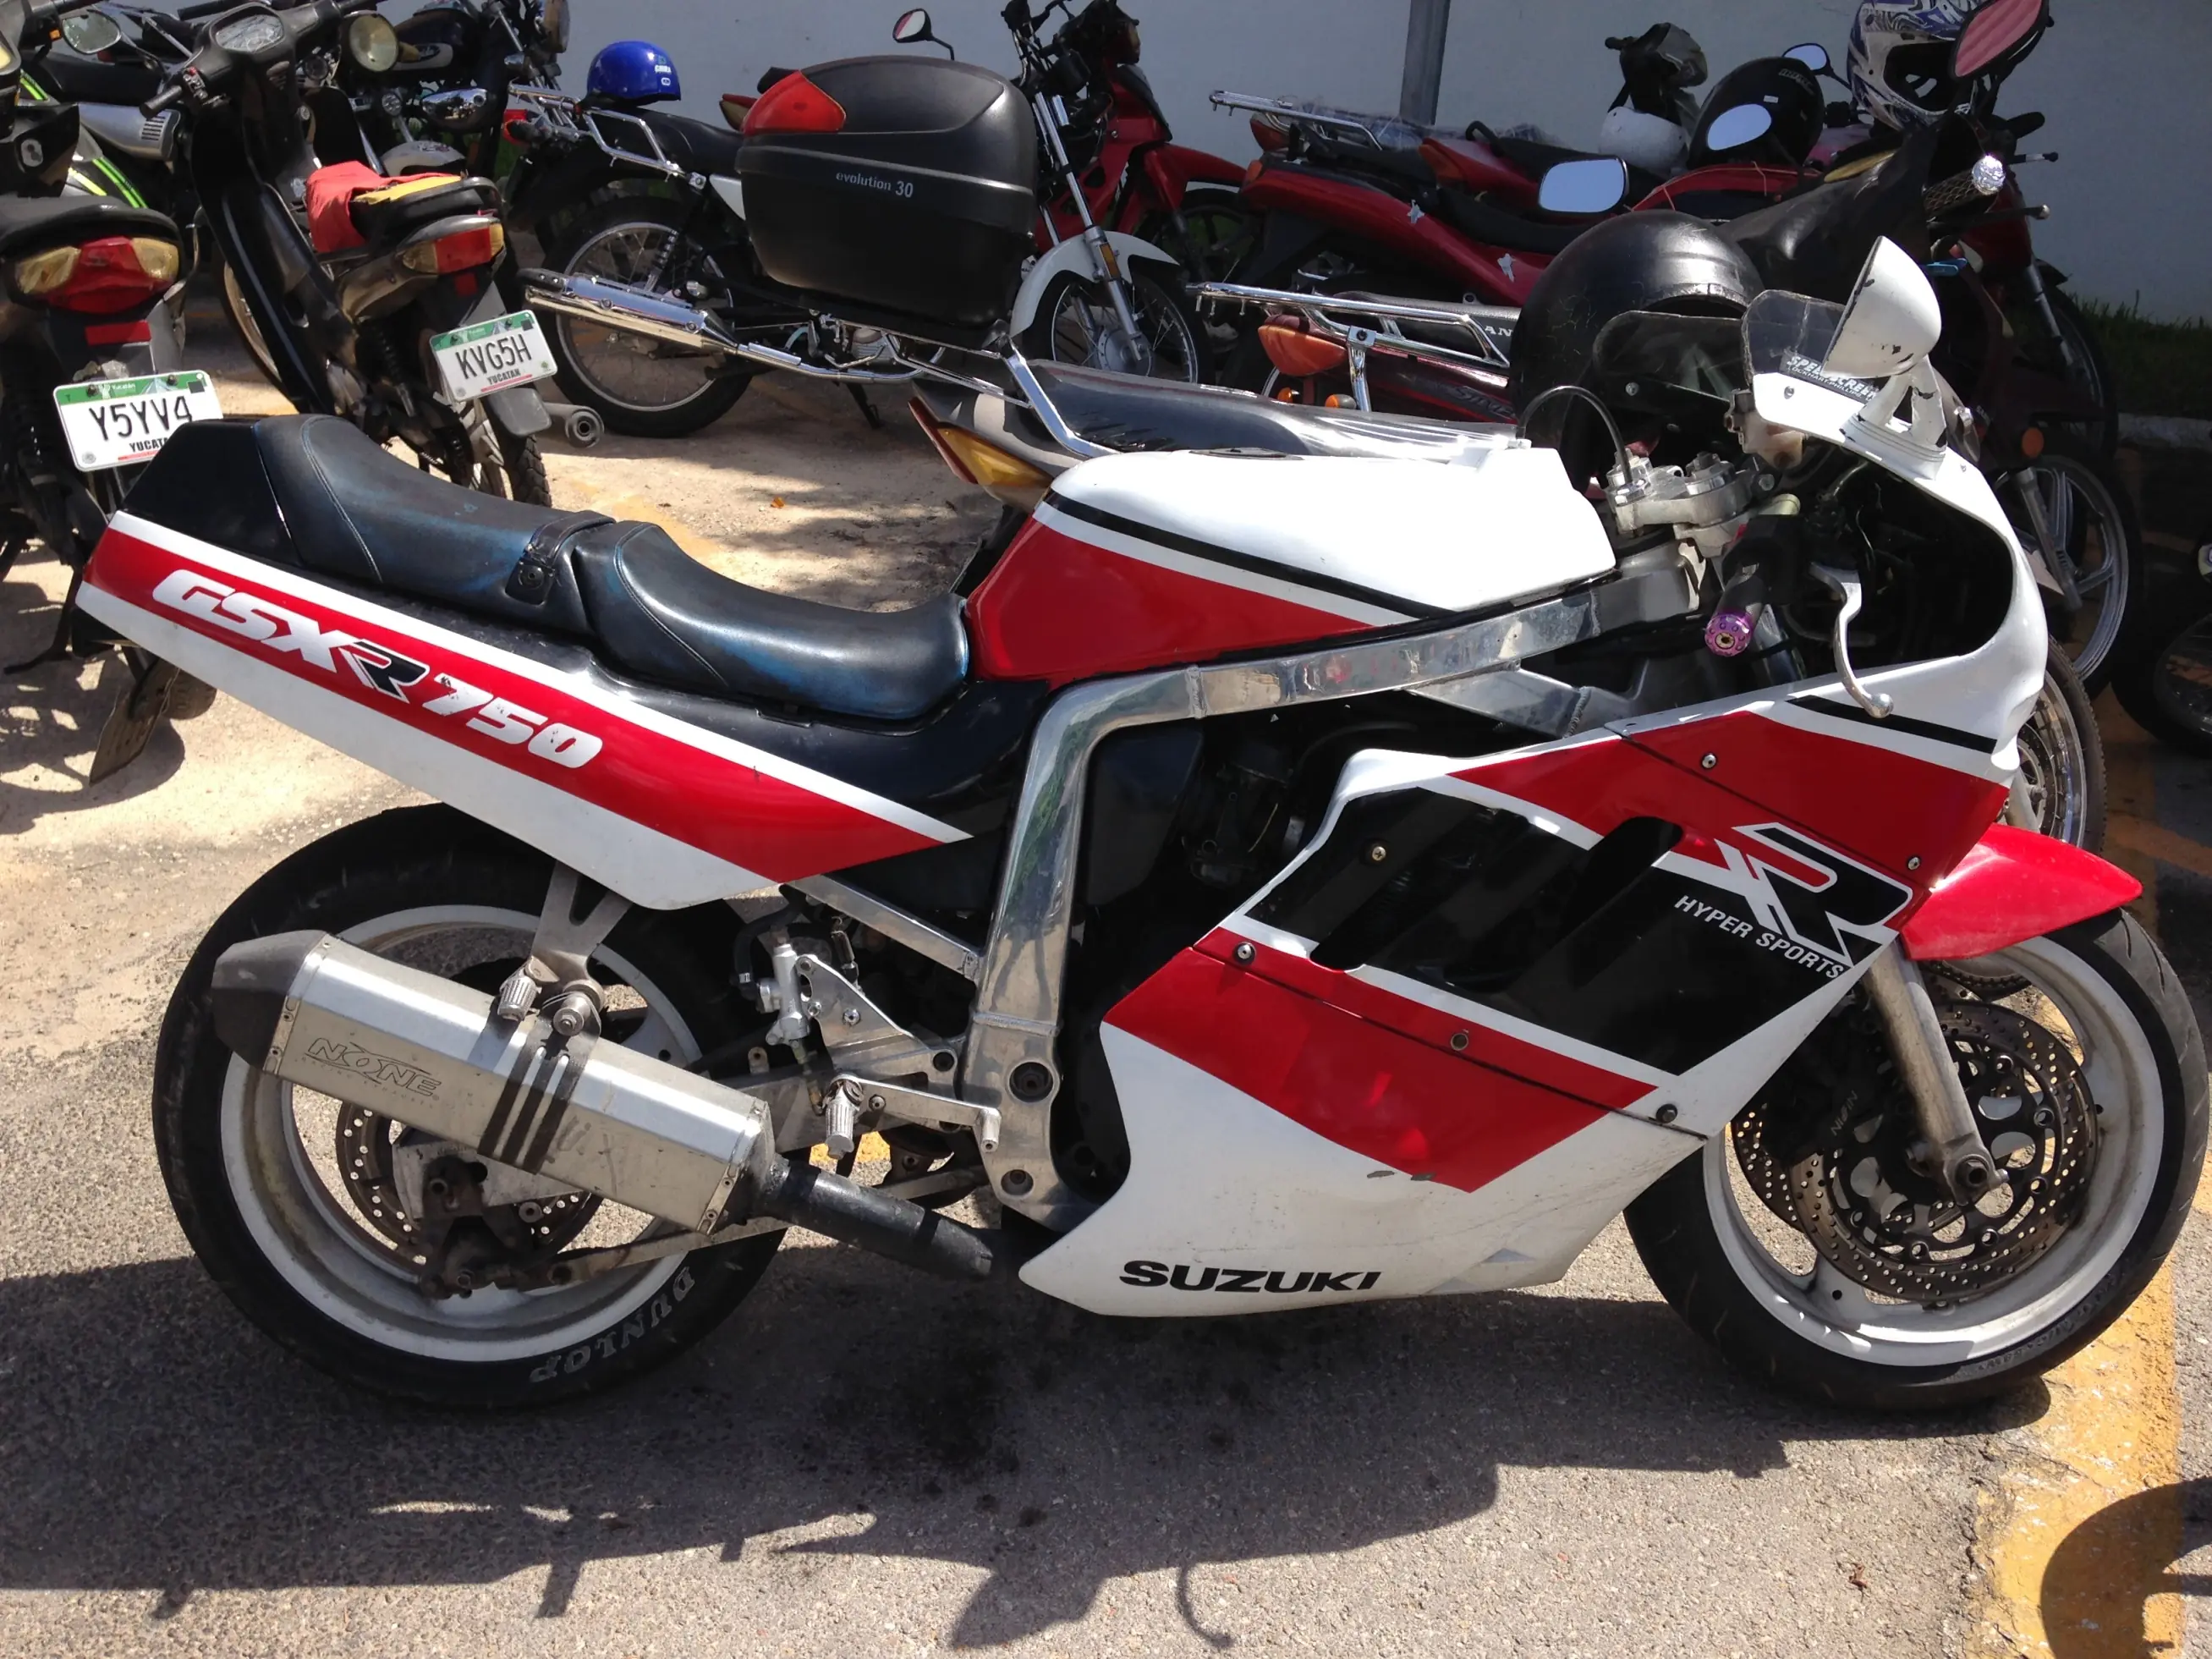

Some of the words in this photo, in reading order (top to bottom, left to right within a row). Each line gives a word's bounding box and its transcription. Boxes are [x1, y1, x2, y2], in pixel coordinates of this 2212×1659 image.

[835, 173, 892, 191] evolution
[895, 180, 914, 198] 30
[455, 333, 532, 380] KVG5H
[487, 368, 522, 386] YUCATAN
[88, 395, 193, 442] Y5YV4
[129, 437, 170, 453] YUCATA
[421, 673, 604, 769] 750
[1674, 894, 1754, 939] HYPER
[1755, 931, 1845, 980] SPORTS
[1118, 1259, 1382, 1294] SUZUKI
[529, 1266, 696, 1383] DUNLOP
